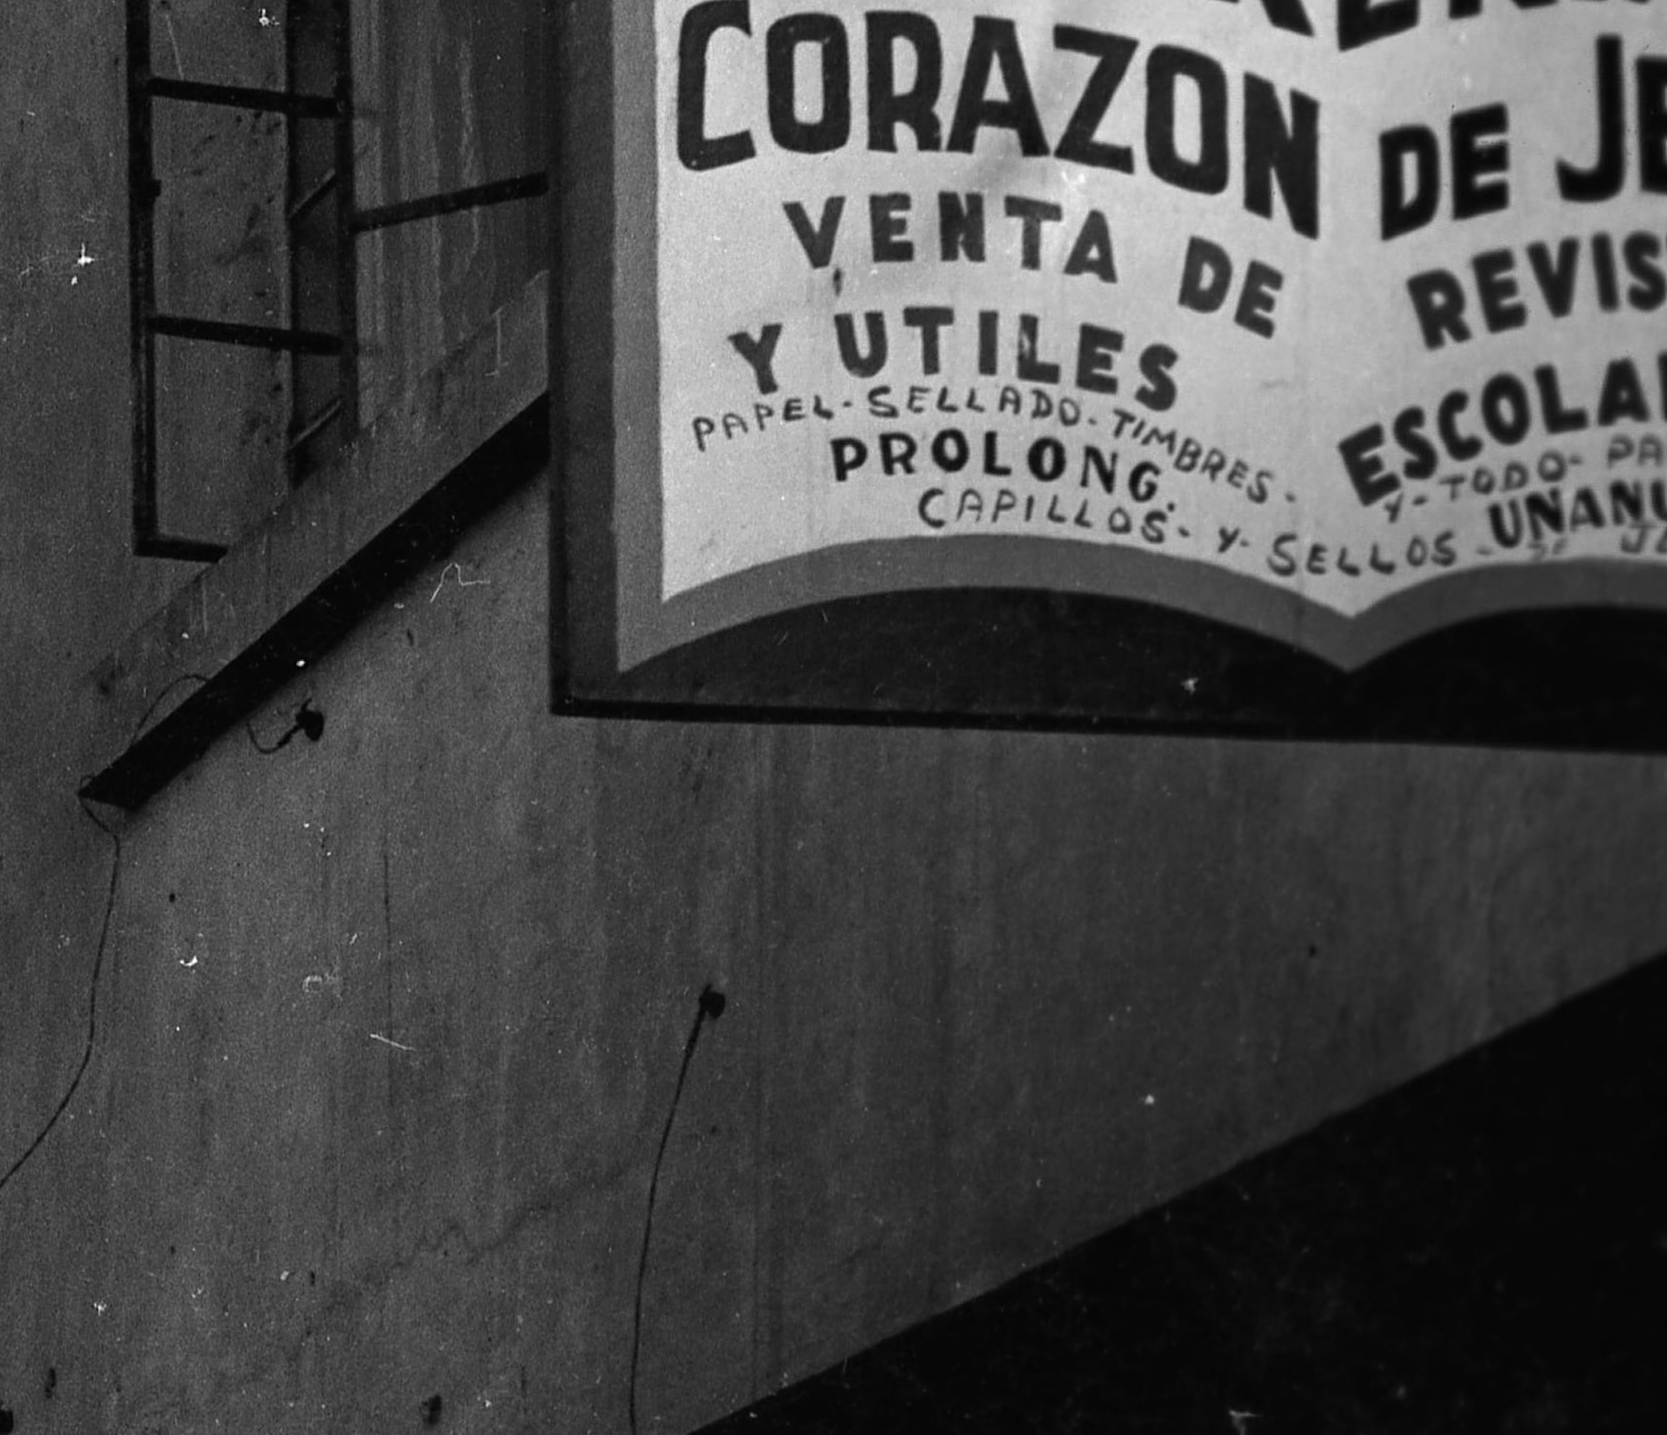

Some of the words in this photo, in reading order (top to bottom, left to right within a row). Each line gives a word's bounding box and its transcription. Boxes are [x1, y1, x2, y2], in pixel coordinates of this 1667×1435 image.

[1378, 103, 1510, 241] DE
[782, 192, 1118, 285] VENTA
[1178, 236, 1285, 339] DE
[727, 322, 784, 396] Y
[833, 306, 1180, 412] UTILES
[1337, 352, 1667, 507] ESCOLA
